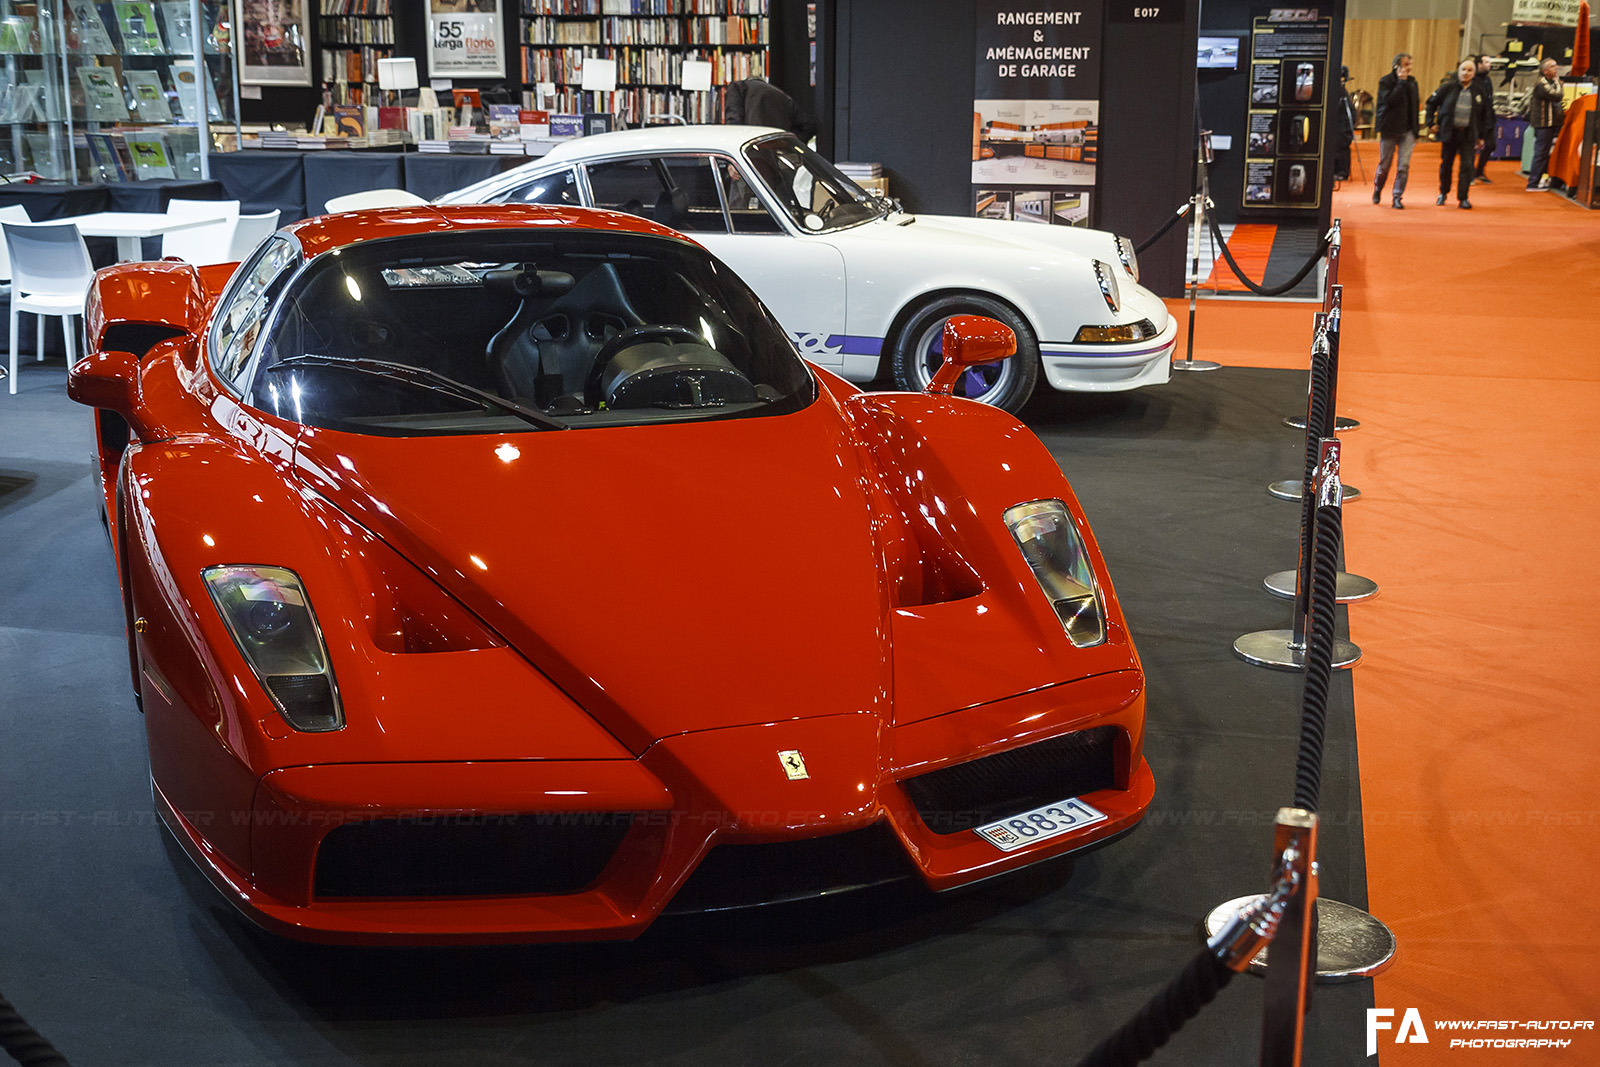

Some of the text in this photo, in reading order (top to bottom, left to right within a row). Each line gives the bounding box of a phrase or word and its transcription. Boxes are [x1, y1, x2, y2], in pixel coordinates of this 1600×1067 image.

[997, 12, 1082, 25] RANGEMENT
[1134, 8, 1159, 17] E 017
[1033, 29, 1044, 42] &
[986, 46, 1090, 60] AMÉNAGEMENT
[998, 65, 1076, 77] DE GARAGE
[1009, 802, 1094, 837] 8831
[998, 834, 1014, 844] MC
